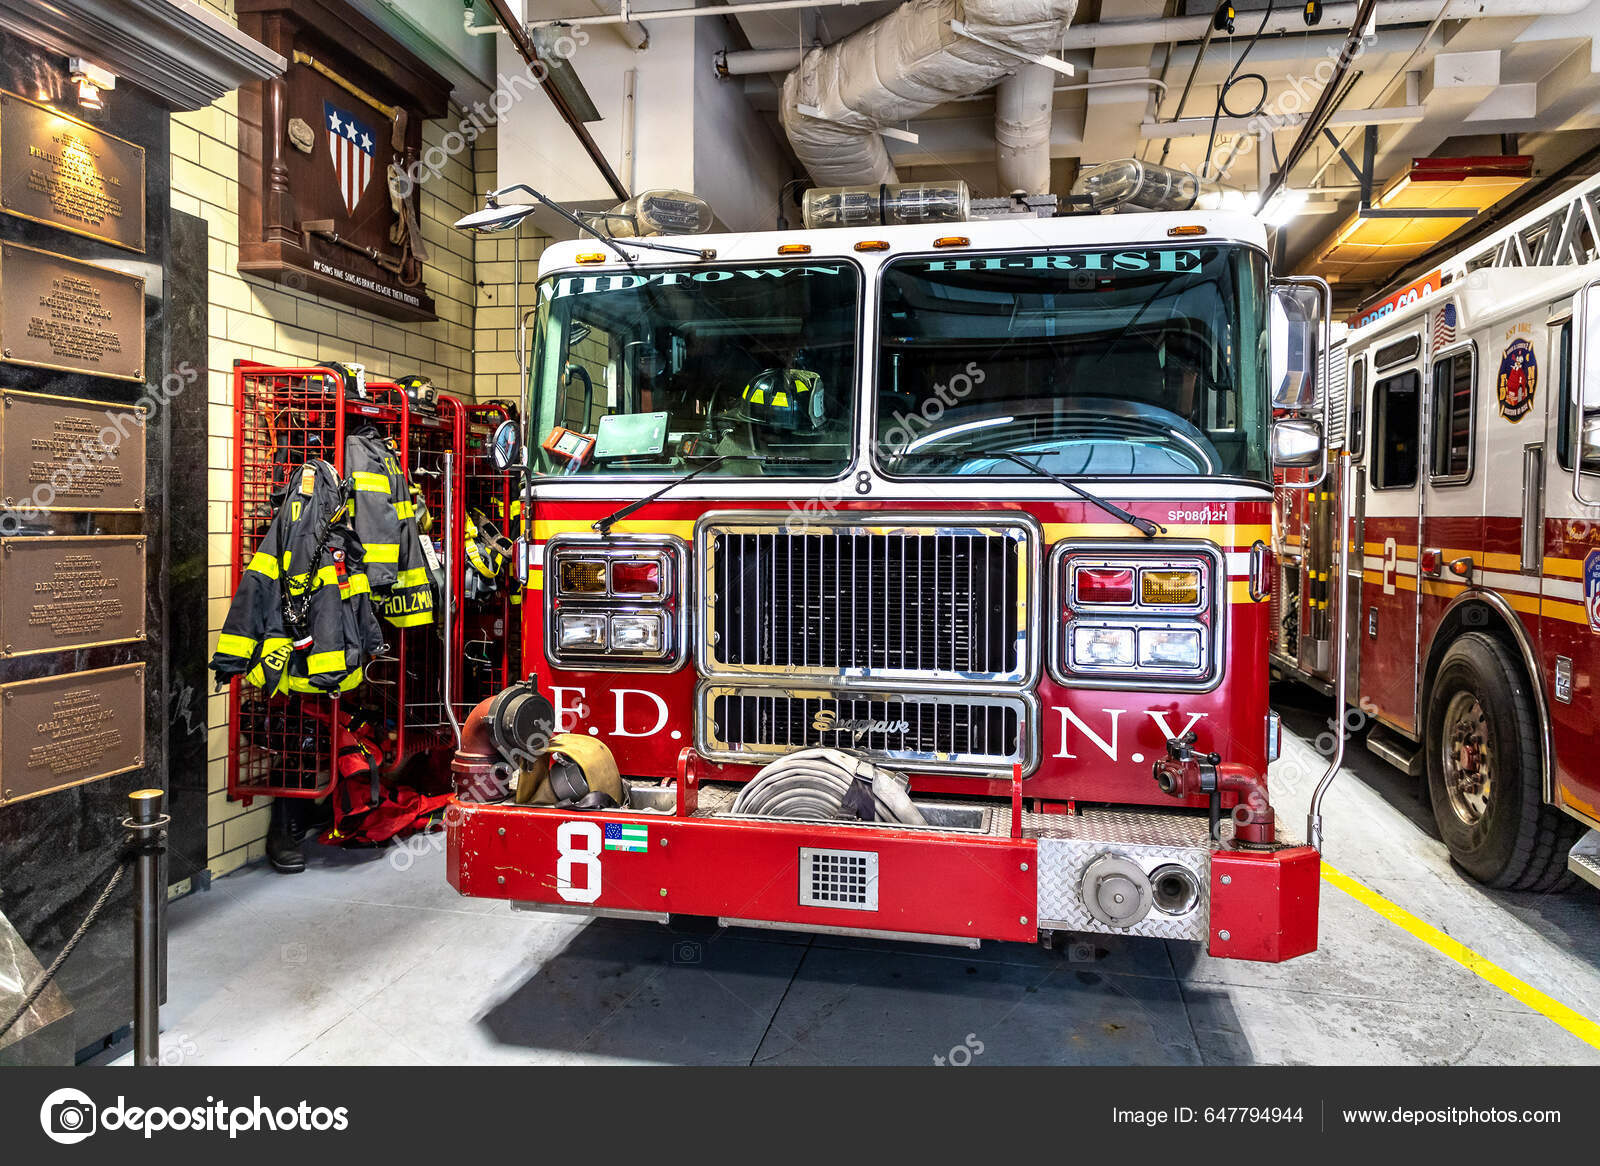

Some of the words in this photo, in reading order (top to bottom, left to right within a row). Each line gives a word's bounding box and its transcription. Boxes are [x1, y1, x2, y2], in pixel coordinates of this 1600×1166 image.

[321, 264, 334, 275] SONS
[345, 272, 356, 284] SONS
[923, 250, 1202, 274] HI-RISE
[537, 266, 842, 307] MIDTOWN
[855, 471, 872, 495] 8
[1383, 537, 1396, 596] 2
[37, 721, 60, 733] CARL
[557, 821, 602, 903] 8
